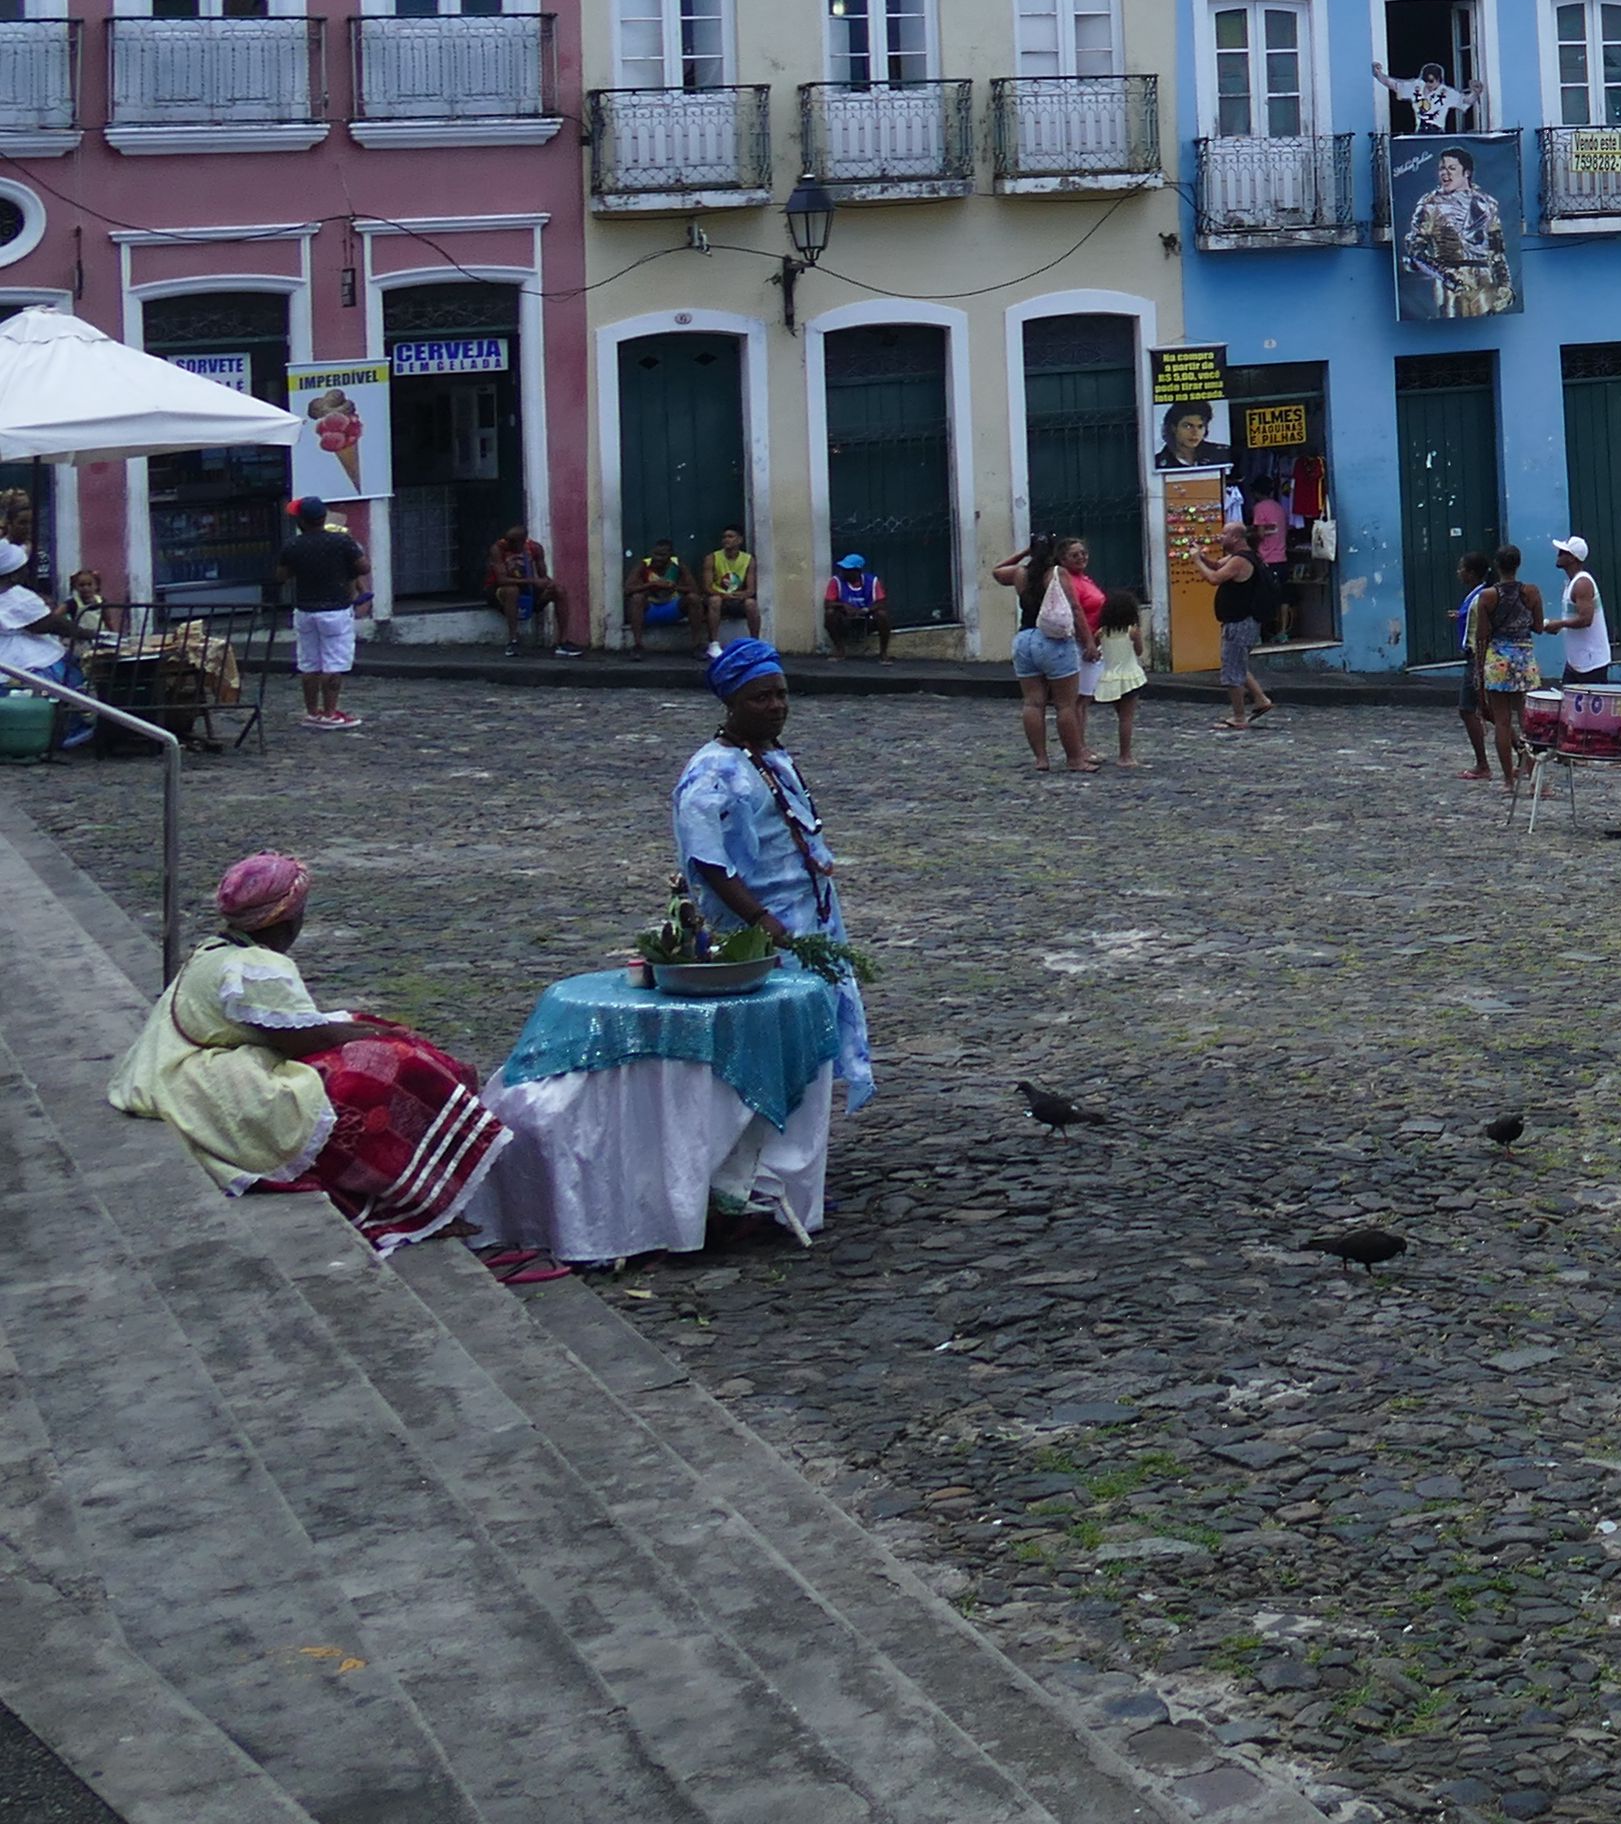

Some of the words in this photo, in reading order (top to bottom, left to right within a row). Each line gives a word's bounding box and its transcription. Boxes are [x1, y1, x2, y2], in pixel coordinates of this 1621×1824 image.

[1575, 133, 1599, 151] Vendo
[1600, 135, 1617, 151] este
[396, 339, 501, 362] CERVEJA
[1163, 353, 1175, 362] Na
[1177, 352, 1214, 362] compra
[176, 358, 244, 374] SORVETE
[396, 362, 429, 374] BEM
[437, 358, 502, 371] GELADA
[1172, 362, 1201, 372] partir
[1201, 361, 1214, 370] de
[299, 369, 379, 390] IMPERDÍVEL
[1155, 383, 1180, 393] pode
[1181, 382, 1203, 391] tirar
[1204, 381, 1223, 389] uma
[1155, 394, 1174, 402] foto
[1249, 408, 1302, 426] FILMES
[1250, 436, 1256, 446] E
[1262, 432, 1303, 445] PILHAS
